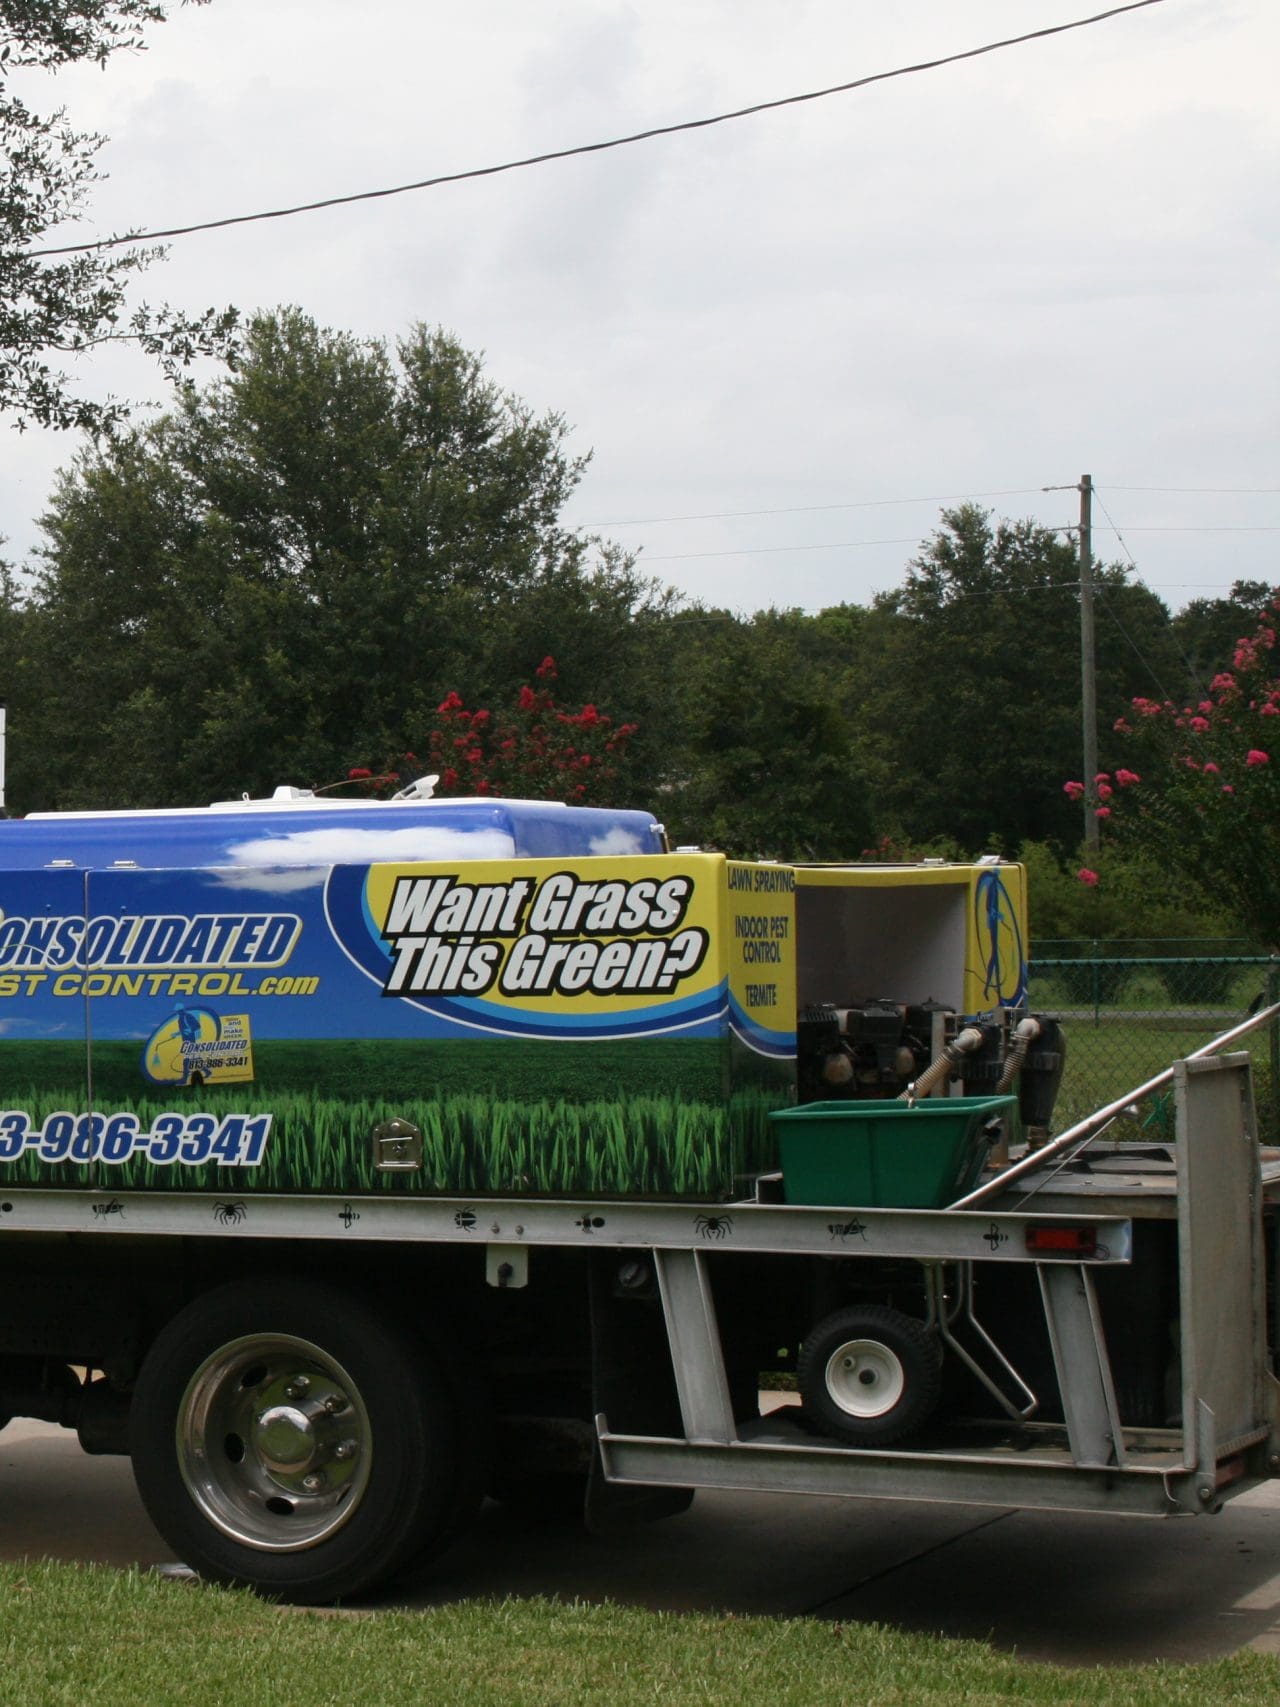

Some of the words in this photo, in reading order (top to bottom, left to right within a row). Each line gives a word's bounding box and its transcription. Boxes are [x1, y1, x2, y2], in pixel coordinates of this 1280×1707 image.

[728, 867, 753, 892] LAWN
[754, 869, 795, 892] SPRAYING
[382, 876, 538, 939] Want
[528, 870, 696, 936] Grass
[735, 916, 768, 938] INDOOR
[770, 916, 788, 938] PEST
[382, 935, 504, 998] This
[499, 927, 710, 998] Green?
[743, 941, 781, 964] CONTROL
[52, 974, 320, 996] CONTROL.com
[745, 984, 777, 1007] TERMITE
[180, 1039, 248, 1054] CONSOLIDATED
[189, 1057, 248, 1069] 813-986-3341
